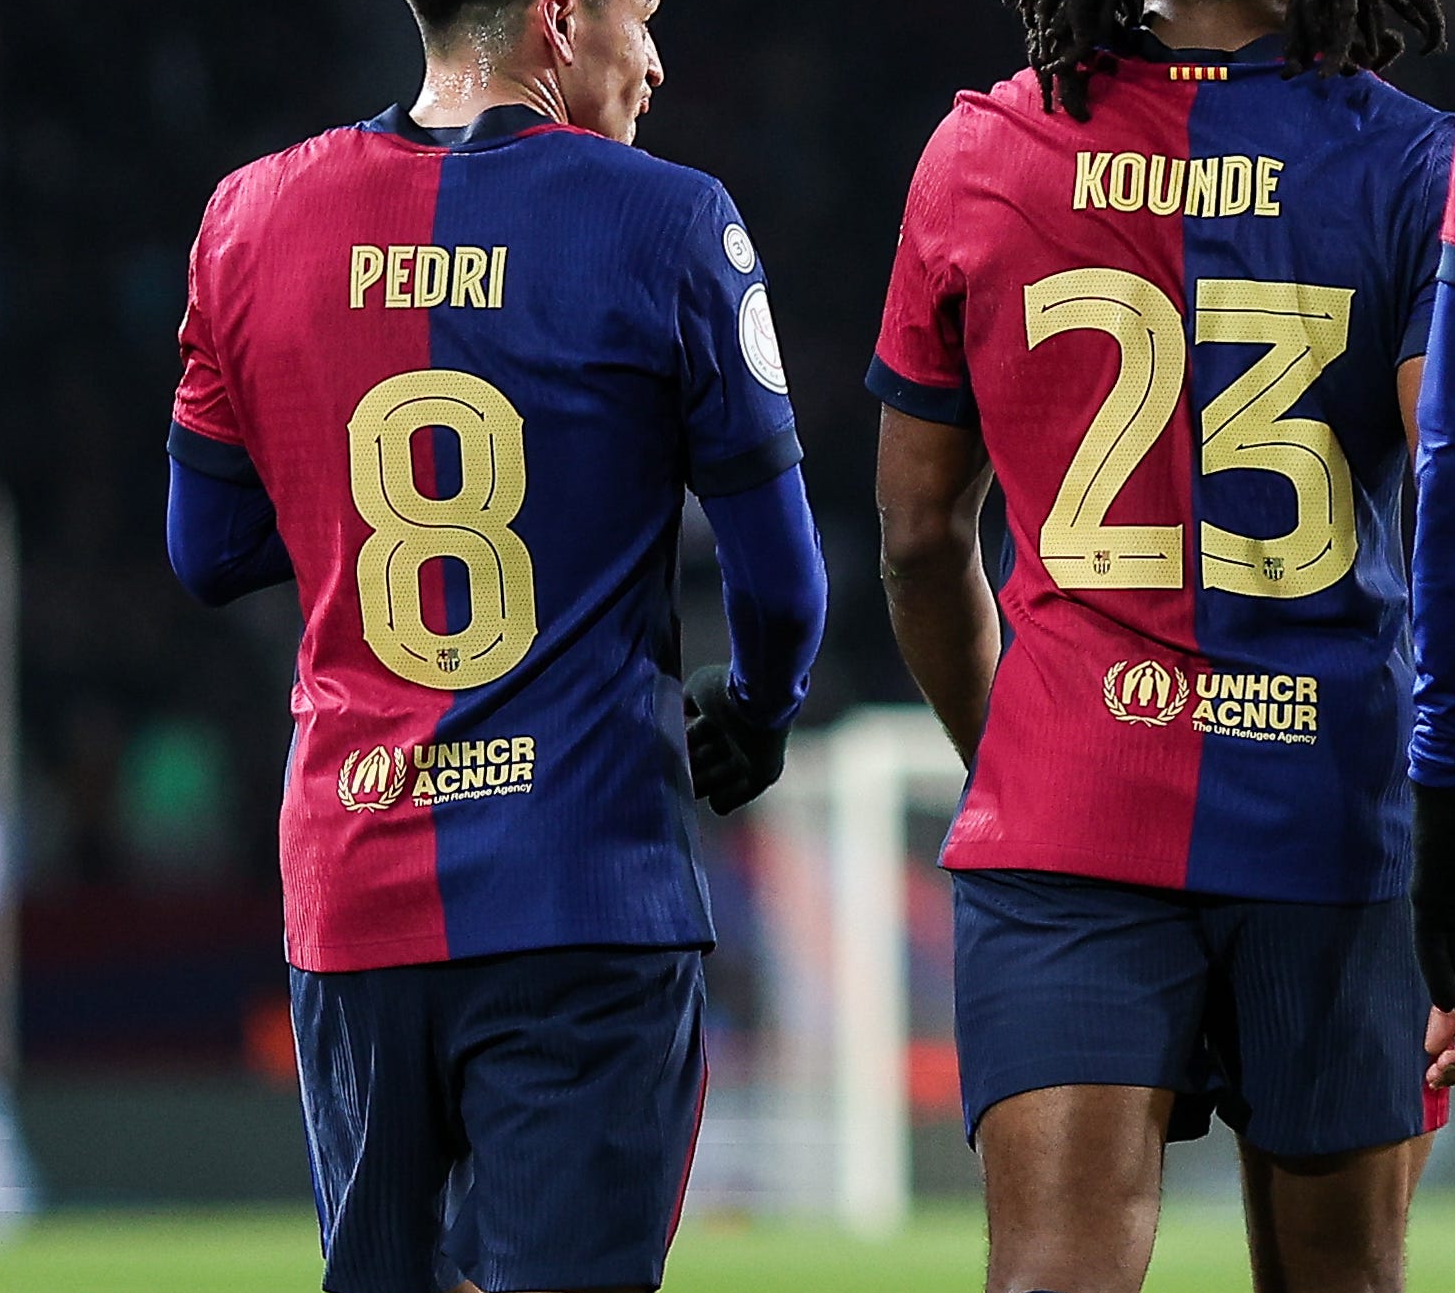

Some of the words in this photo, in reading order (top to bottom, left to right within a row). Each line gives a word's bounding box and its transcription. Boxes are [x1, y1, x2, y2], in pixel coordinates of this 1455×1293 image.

[1072, 150, 1285, 218] KOUNDE
[349, 245, 508, 310] PEDRI
[1023, 267, 1358, 599] 23
[347, 369, 539, 690] 8
[1195, 674, 1318, 703] UNHCR
[1192, 700, 1317, 731] ACNUR
[1192, 720, 1213, 733] The
[1214, 725, 1231, 736] UN
[1231, 728, 1276, 741] Refugee
[1277, 731, 1317, 745] Agency
[412, 736, 536, 770] UNHCR
[411, 762, 534, 797] ACNUR
[412, 798, 433, 808] The
[434, 794, 449, 805] UN
[450, 789, 492, 802] Refugee
[493, 784, 532, 797] Agency
